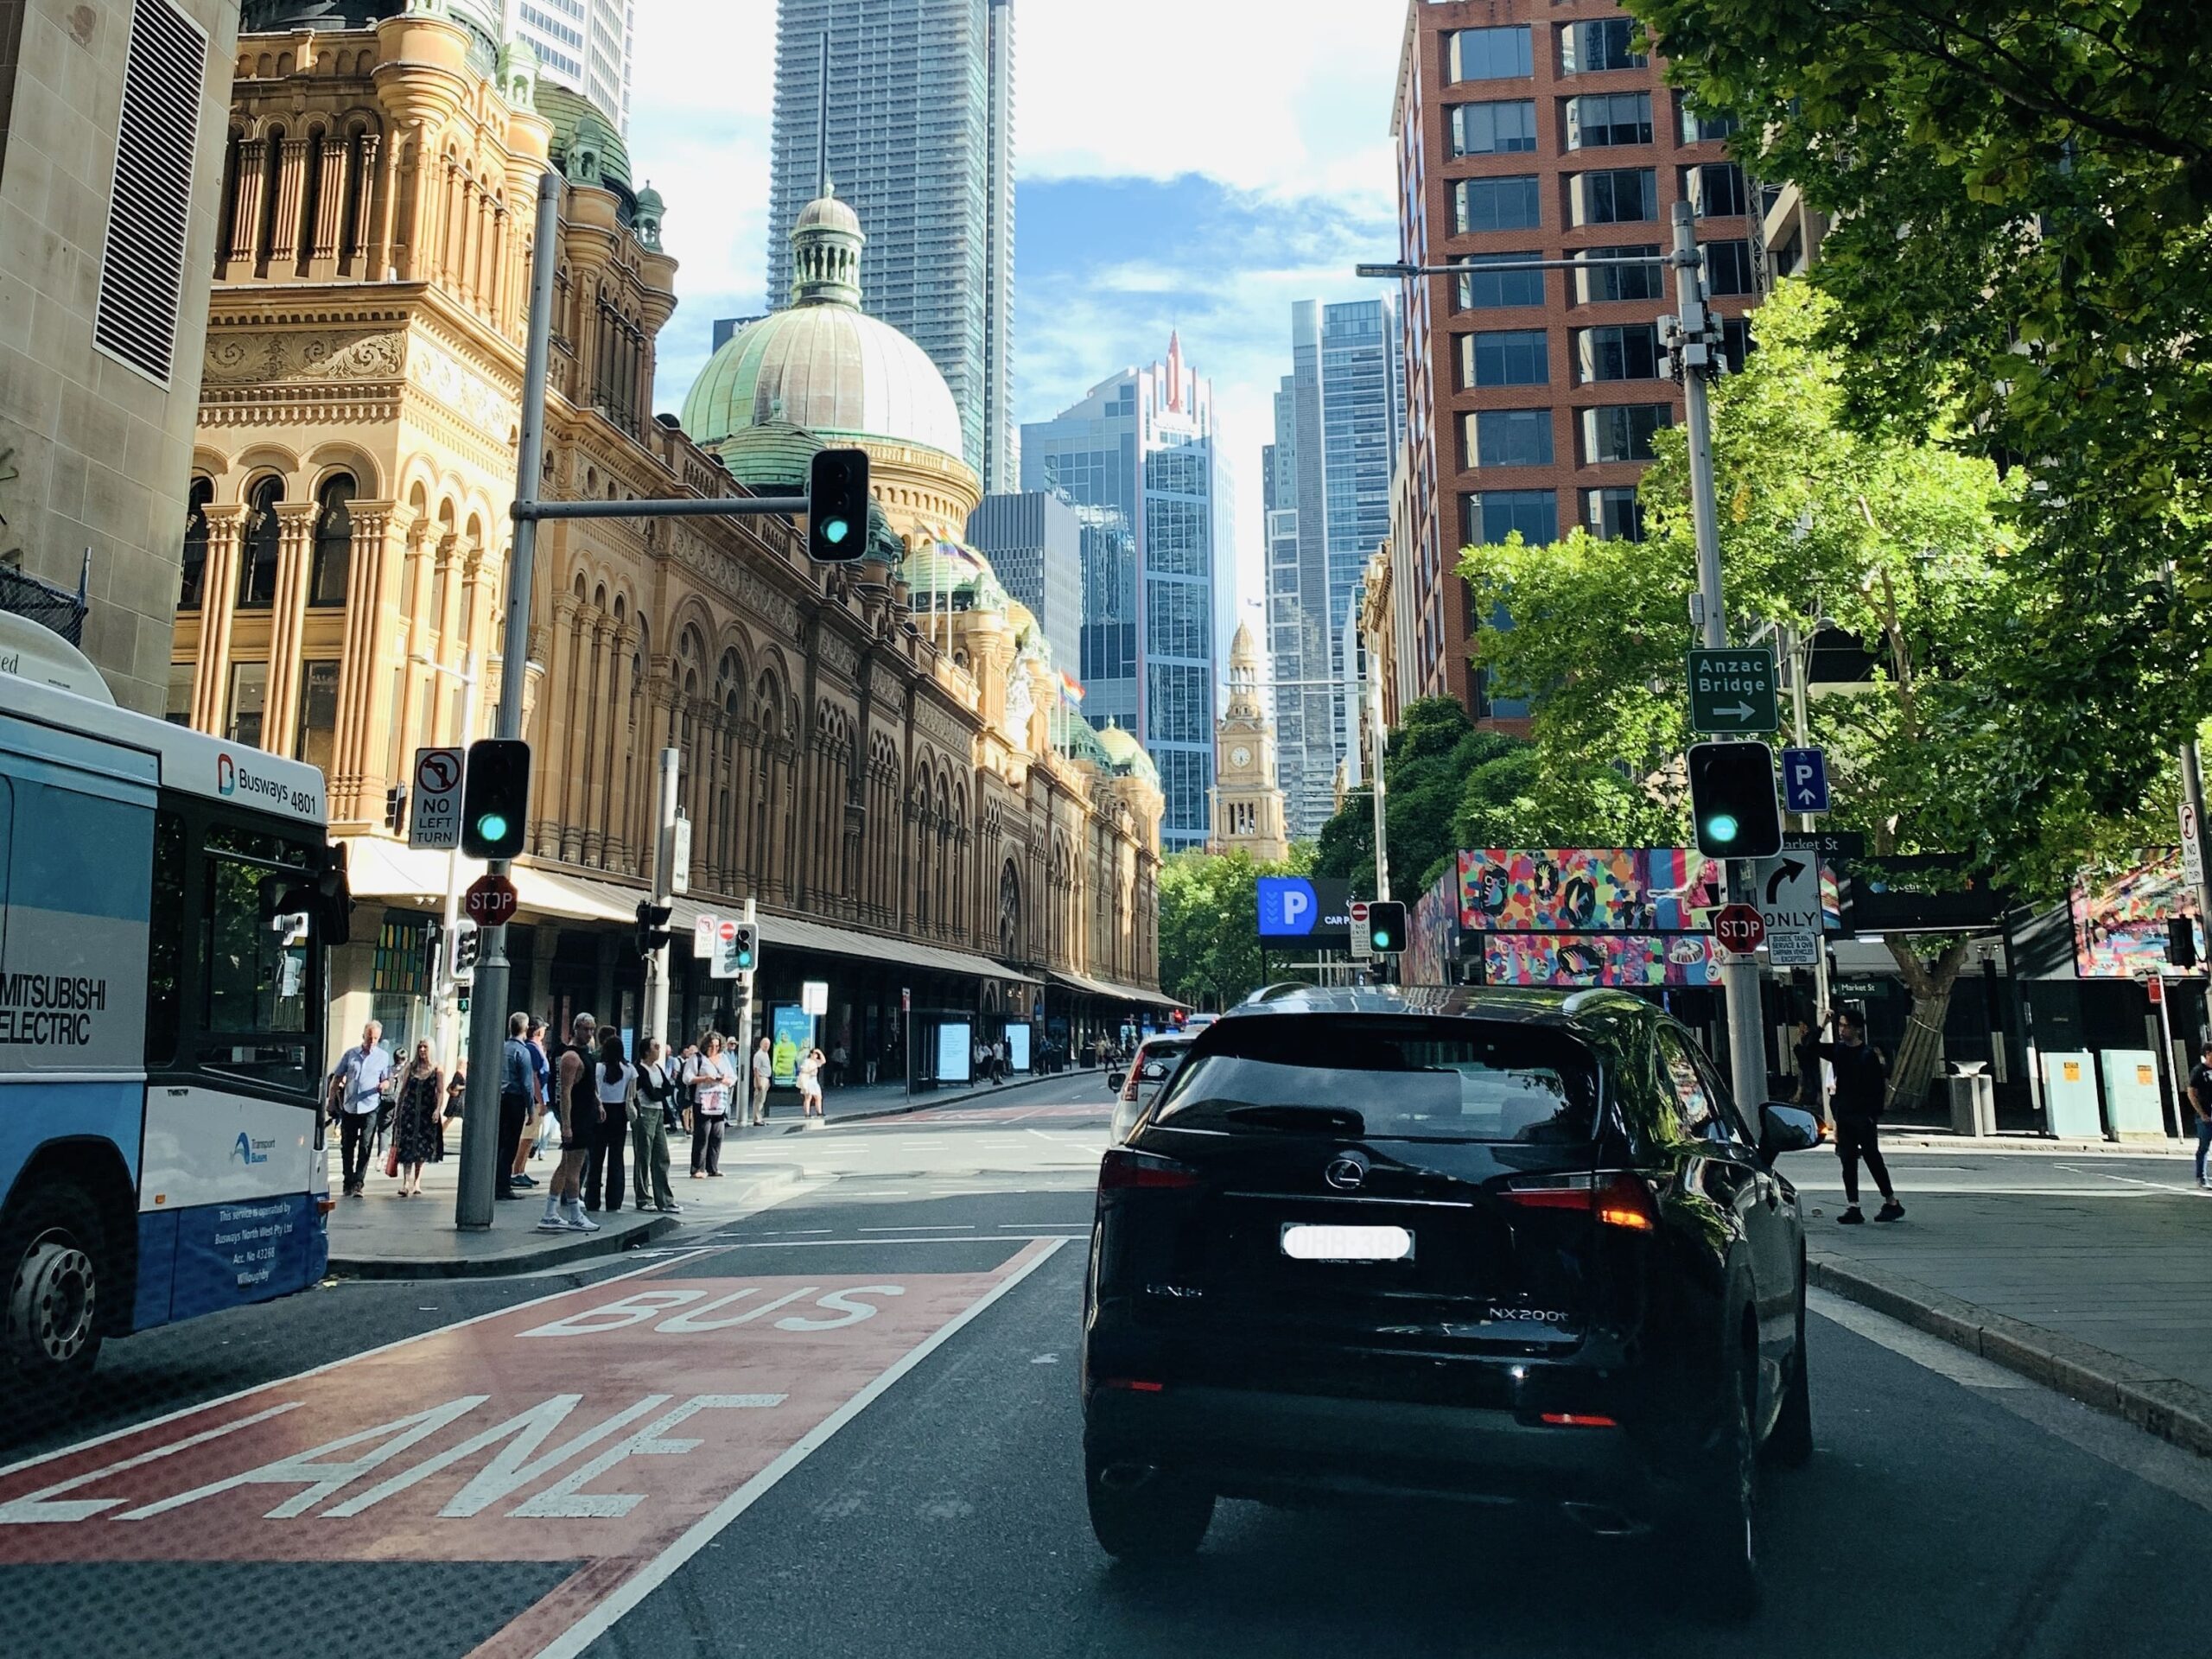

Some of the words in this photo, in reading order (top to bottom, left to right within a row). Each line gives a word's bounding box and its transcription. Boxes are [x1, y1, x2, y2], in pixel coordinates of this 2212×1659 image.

[1699, 658, 1764, 672] Anzac
[1699, 678, 1765, 696] Bridge
[1795, 765, 1813, 785] P
[239, 768, 288, 804] Busways
[291, 791, 316, 815] 4801
[423, 798, 449, 813] NO
[419, 817, 453, 829] LEFT
[416, 831, 453, 842] TURN
[1783, 838, 1821, 850] arket
[1825, 837, 1839, 850] St
[2187, 843, 2196, 855] NO
[470, 892, 512, 910] STOP
[1283, 891, 1308, 925] P
[1325, 916, 1343, 925] CAR
[1344, 916, 1351, 925] P
[1764, 912, 1816, 926] ONLY
[1720, 920, 1760, 938] STOP
[0, 972, 105, 1010] MITSUBISHI
[1840, 983, 1866, 992] Market
[1867, 983, 1875, 992] St
[0, 1010, 91, 1046] ELECTRIC
[251, 1138, 276, 1150] Transport
[251, 1153, 267, 1163] Buses
[219, 1211, 232, 1222] This
[232, 1208, 252, 1220] service
[253, 1208, 258, 1217] is
[259, 1204, 283, 1217] operated
[283, 1201, 291, 1215] by
[214, 1233, 241, 1245] Busways
[242, 1227, 258, 1240] North
[259, 1225, 273, 1236] West
[274, 1224, 283, 1236] Pty
[283, 1222, 293, 1233] Ltd
[246, 1251, 256, 1262] No
[257, 1247, 276, 1260] 43268
[237, 1268, 270, 1285] Willoughby
[514, 1285, 906, 1338] BUS
[0, 1394, 790, 1523] LANE
